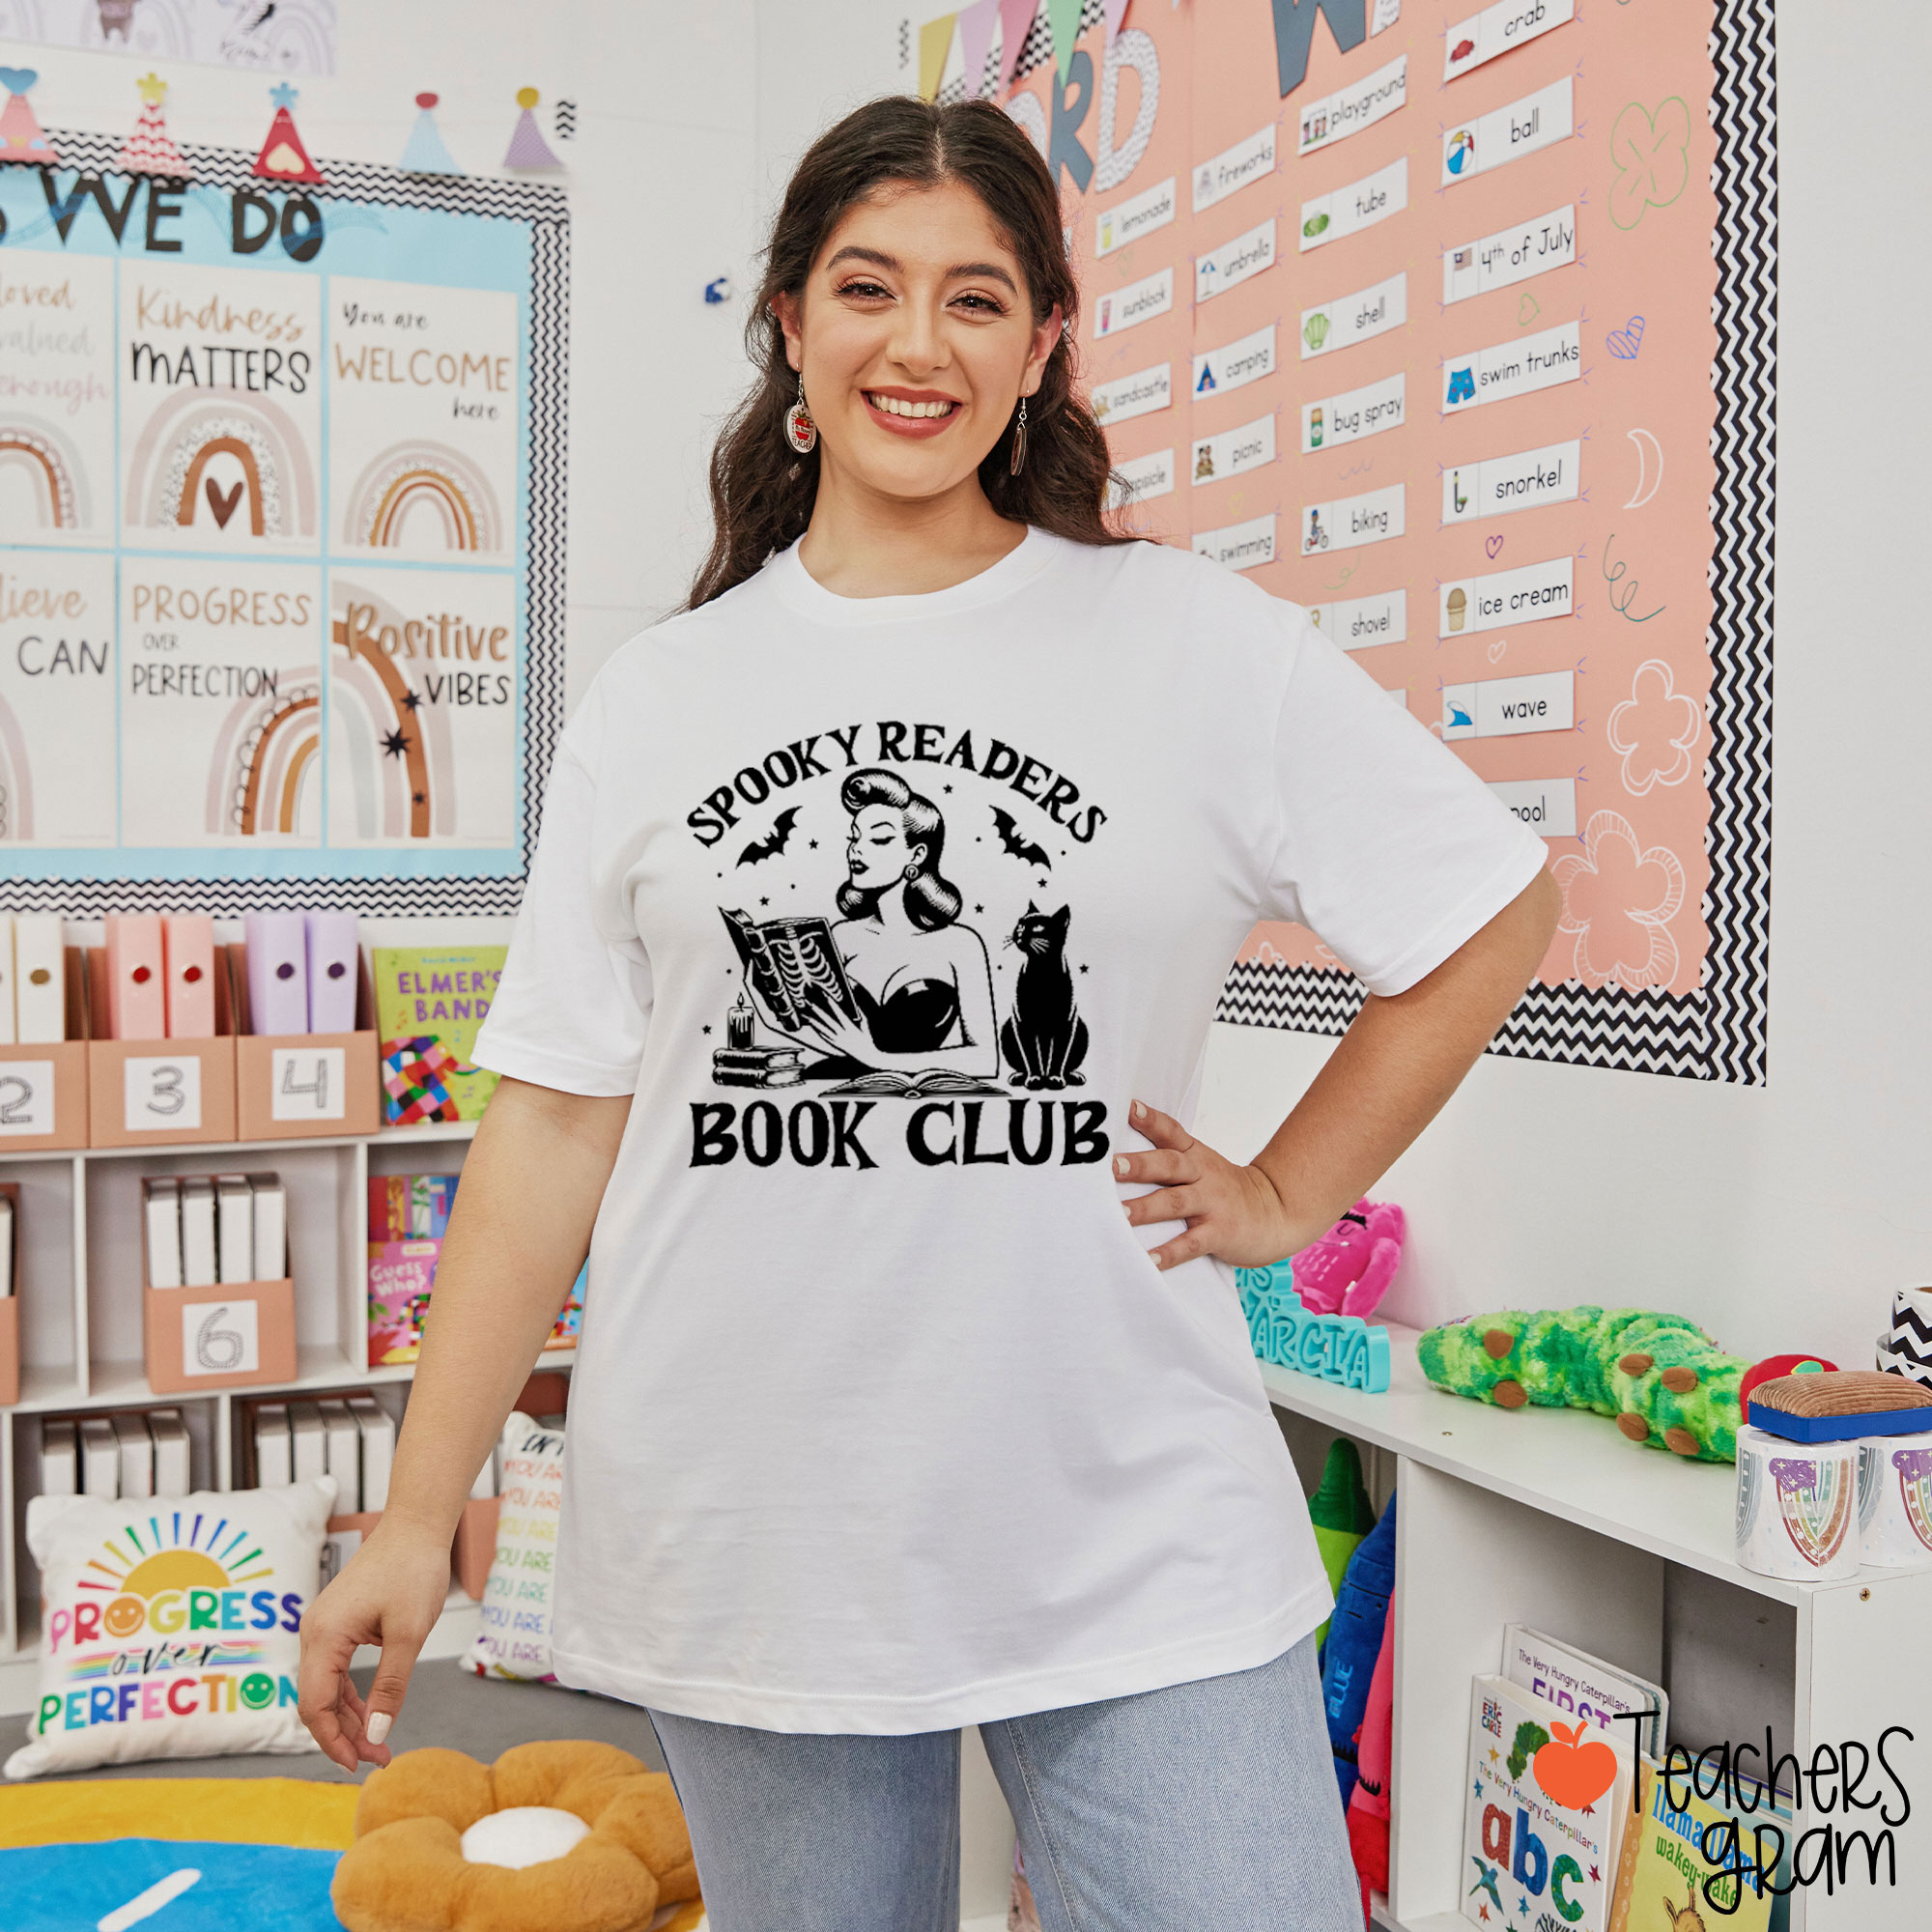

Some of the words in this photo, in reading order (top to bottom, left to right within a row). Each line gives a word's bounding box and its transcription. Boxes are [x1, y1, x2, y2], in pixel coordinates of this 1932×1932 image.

[1505, 3, 1546, 37] crab
[1331, 64, 1406, 131] playground
[1510, 107, 1541, 145] ball
[1218, 144, 1274, 186] fireworks
[40, 167, 185, 253] WE
[232, 192, 326, 263] DO
[1121, 193, 1173, 233] lemonade
[1355, 188, 1386, 216] tube
[1224, 240, 1270, 277] umbrella
[1481, 242, 1505, 273] 4th
[1512, 236, 1532, 266] of
[1538, 223, 1574, 257] July
[135, 286, 305, 343] Kindness
[342, 303, 385, 330] You
[393, 313, 429, 330] are
[1122, 286, 1167, 319] sunblock
[1355, 296, 1386, 329] shell
[334, 343, 512, 392] WELCOME
[1226, 349, 1269, 379] camping
[1480, 362, 1521, 386] swim
[1526, 340, 1580, 374] trunks
[452, 397, 500, 421] here
[1333, 411, 1360, 434] bug
[1364, 397, 1403, 428] spray
[1232, 439, 1264, 469] picnic
[1495, 459, 1563, 498] snorkel
[1351, 508, 1389, 534] biking
[1220, 535, 1272, 563] swimming
[132, 585, 313, 627] PROGRESS
[1478, 597, 1503, 617] ice
[1510, 583, 1569, 611] cream
[348, 602, 510, 662] Positive
[1351, 607, 1391, 638] shovel
[17, 636, 108, 676] CAN
[143, 634, 180, 652] OVER
[132, 664, 278, 697] PERFECTION
[424, 671, 512, 706] VIBES
[1501, 699, 1548, 720] wave
[687, 723, 864, 849] SPOOKY
[876, 721, 1109, 844] READERS
[414, 998, 491, 1023] BAND
[0, 1075, 34, 1124] 2
[146, 1064, 186, 1116] 3
[280, 1058, 328, 1110] 4
[688, 1099, 880, 1169] BOOK
[905, 1097, 1111, 1168] CLUB
[370, 1262, 422, 1283] Guess
[374, 1273, 427, 1297] Who?
[196, 1305, 245, 1371] 6
[1241, 1301, 1370, 1387] ARCIA
[50, 1590, 304, 1656] PROGRESS
[112, 1641, 249, 1676] over
[1327, 1660, 1353, 1719] BLUE
[1519, 1648, 1532, 1665] The
[1533, 1656, 1549, 1677] Very
[1550, 1665, 1578, 1691] Hungry
[1580, 1680, 1631, 1715] Caterpillar's
[1481, 1715, 1502, 1739] CARLE
[1482, 1701, 1503, 1725] ERIC
[1479, 1760, 1492, 1780] The
[1493, 1772, 1513, 1798] Very
[1513, 1785, 1543, 1820] Hungry
[1544, 1808, 1598, 1855] Caterpillar's
[1481, 1803, 1585, 1923] abc
